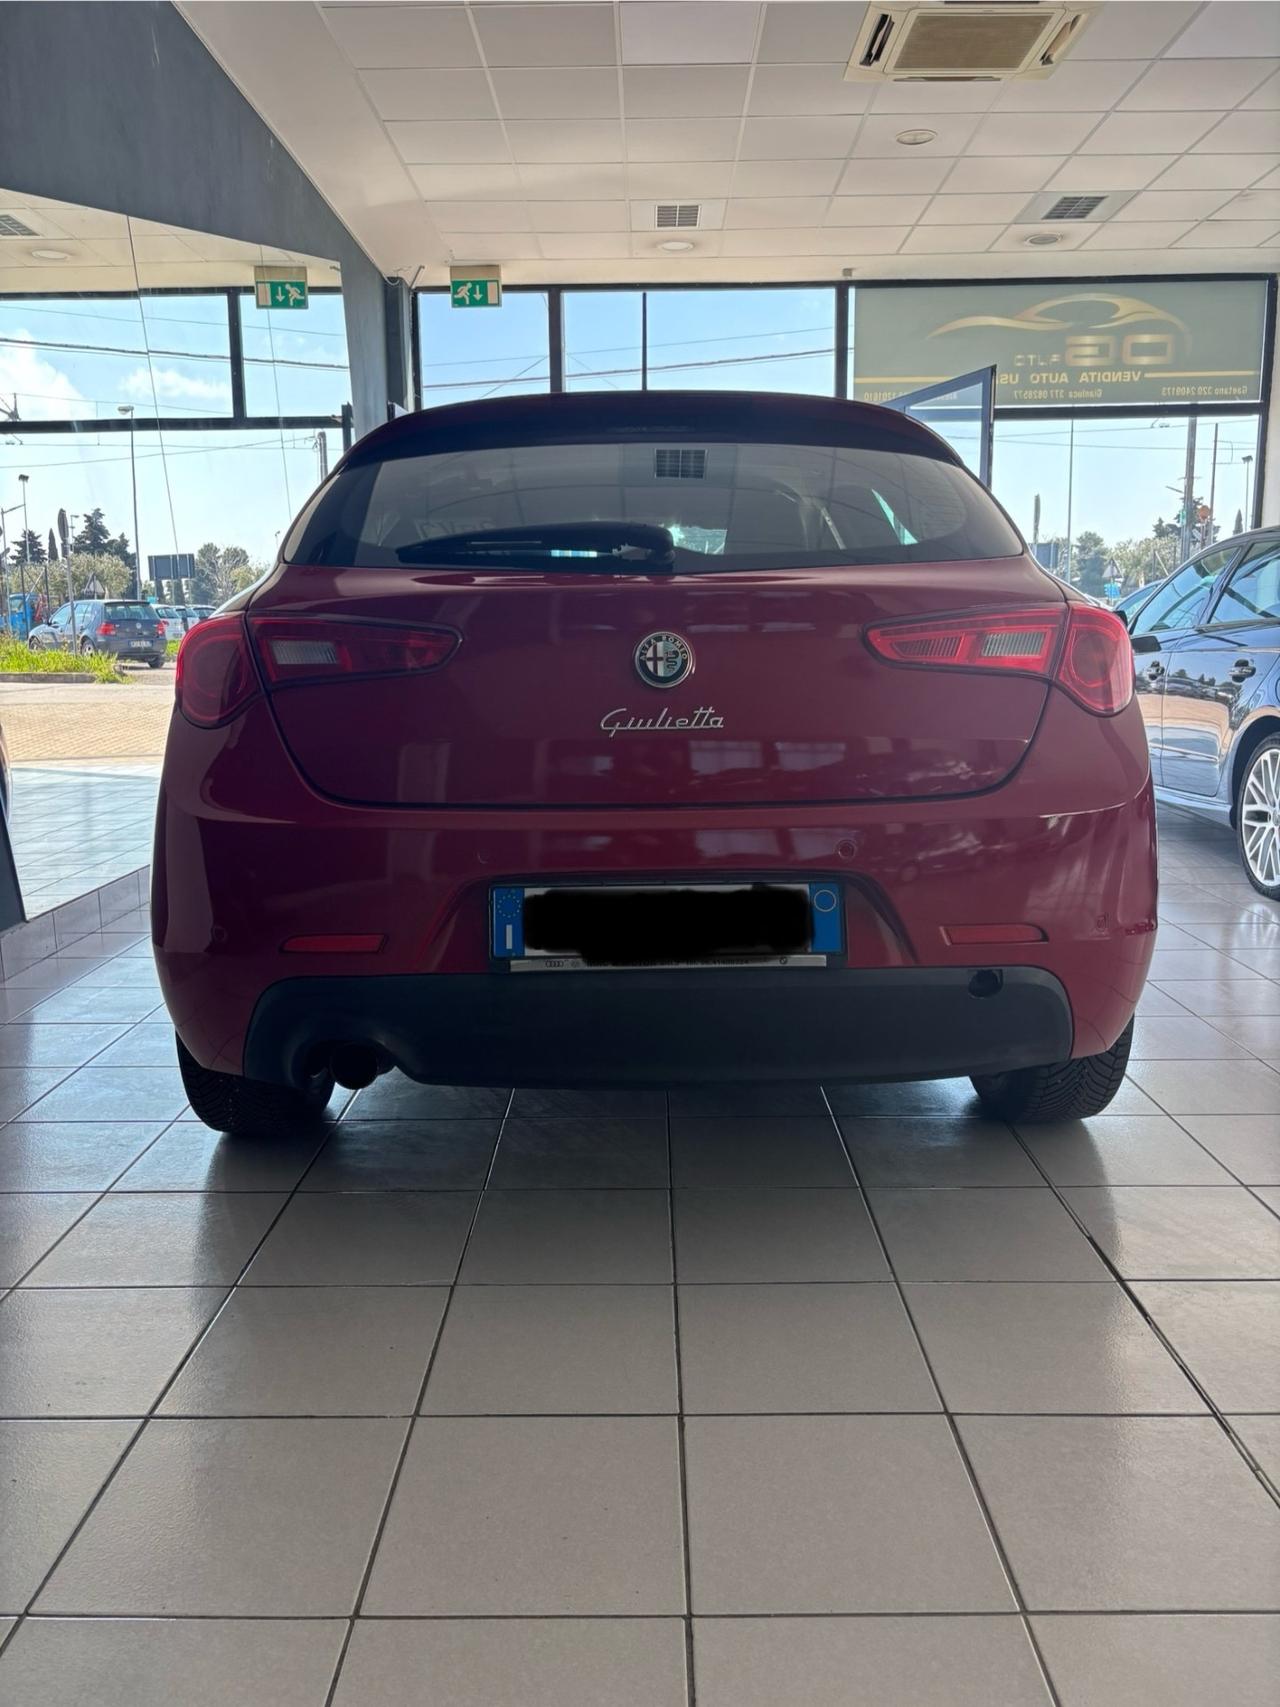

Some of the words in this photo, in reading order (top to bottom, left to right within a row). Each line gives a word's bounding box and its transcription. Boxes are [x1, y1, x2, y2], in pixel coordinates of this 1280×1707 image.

[639, 637, 658, 661] ALFA
[661, 634, 689, 660] ROMEO
[600, 706, 724, 738] Giulietta
